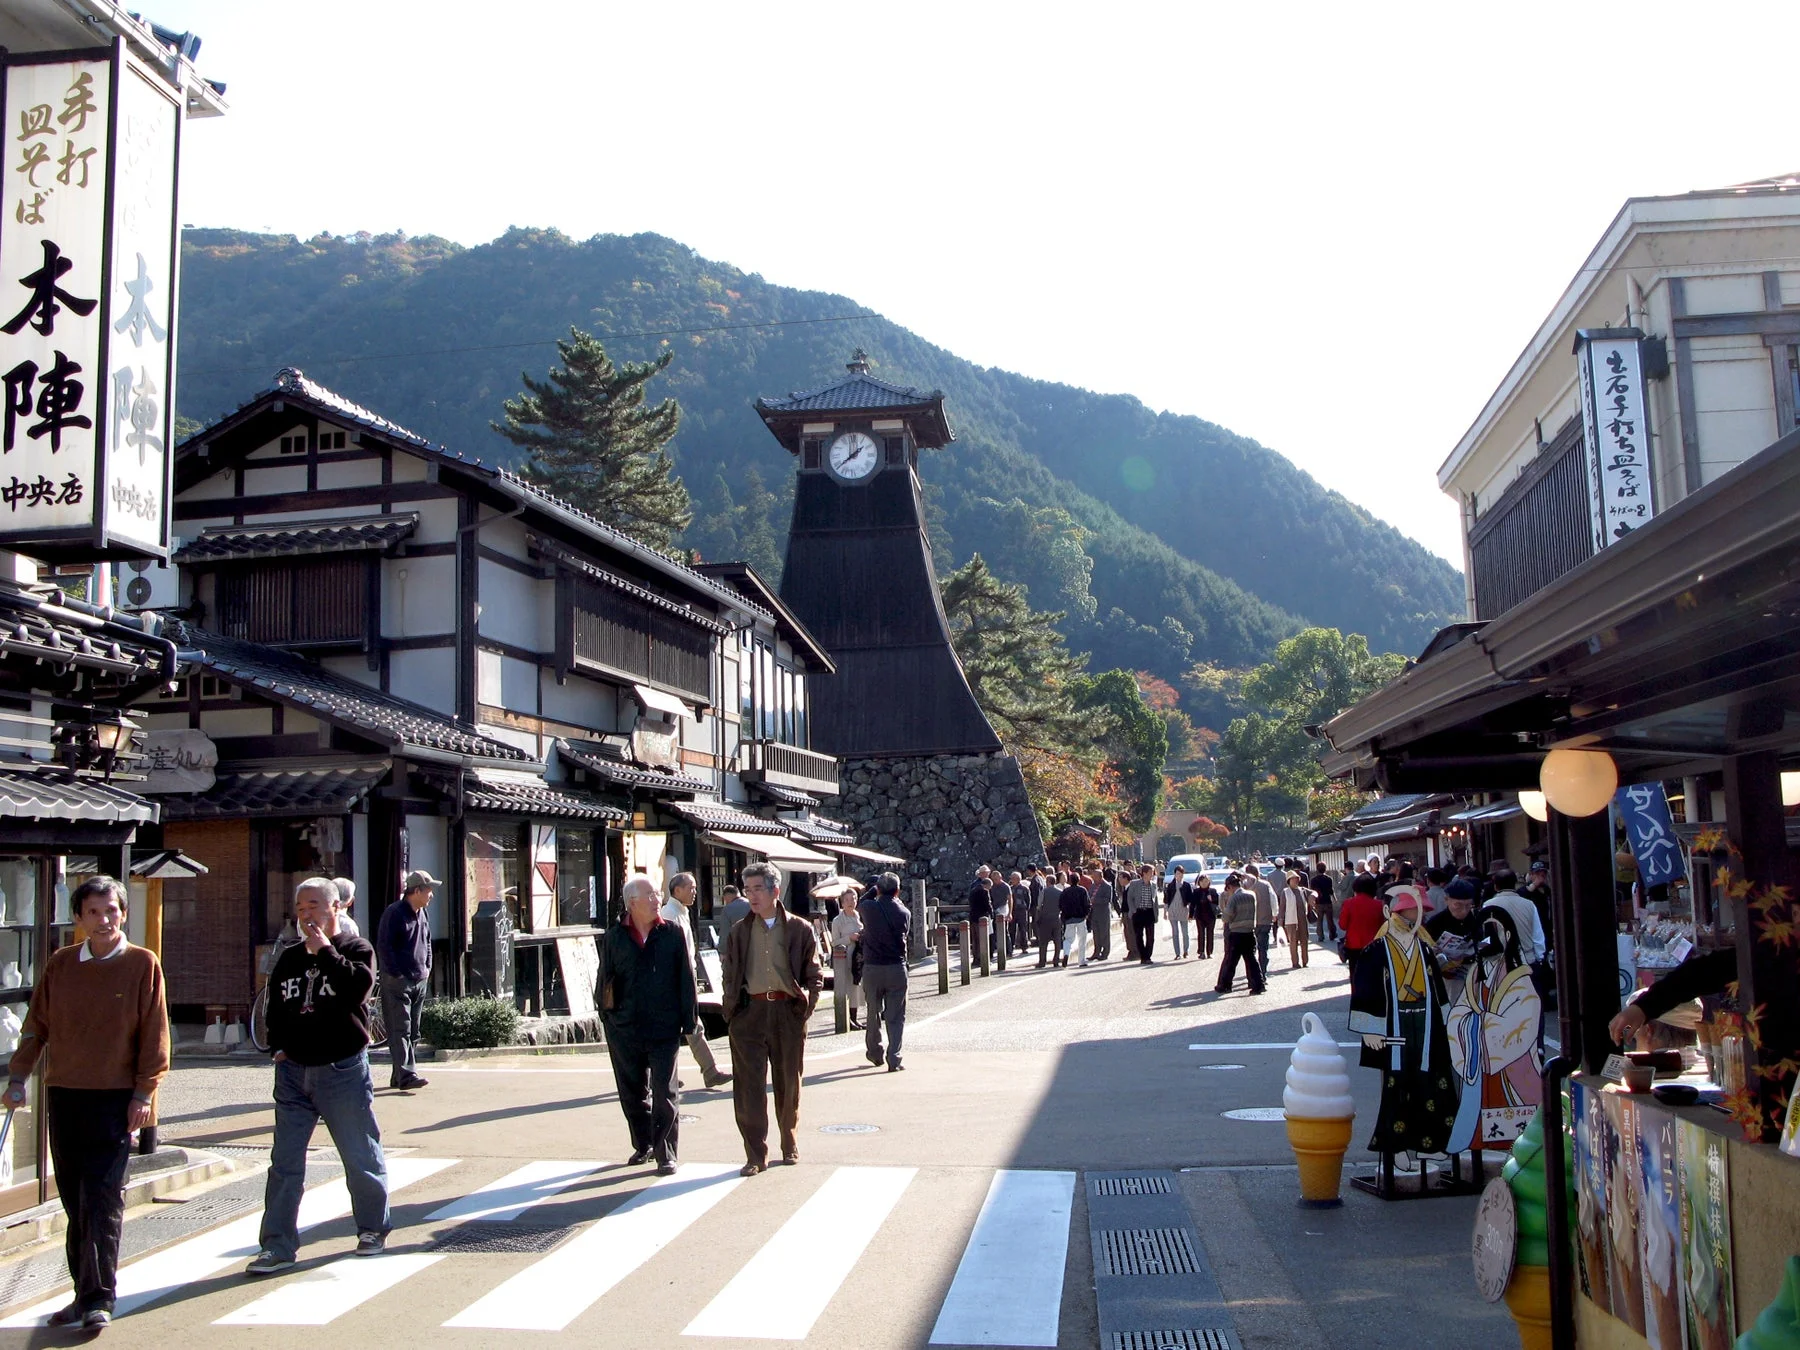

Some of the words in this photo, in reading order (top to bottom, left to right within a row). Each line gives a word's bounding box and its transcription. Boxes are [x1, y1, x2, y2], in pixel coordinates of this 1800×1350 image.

[16, 104, 57, 225] 皿そば
[57, 72, 97, 188] 手打
[0, 239, 98, 454] 本陣
[1605, 350, 1642, 498] 出石手打ち皿そば
[1, 473, 84, 512] 中央店
[111, 477, 157, 521] 中央店
[1589, 1098, 1601, 1190] そば茶
[1661, 1122, 1673, 1205] バニラ
